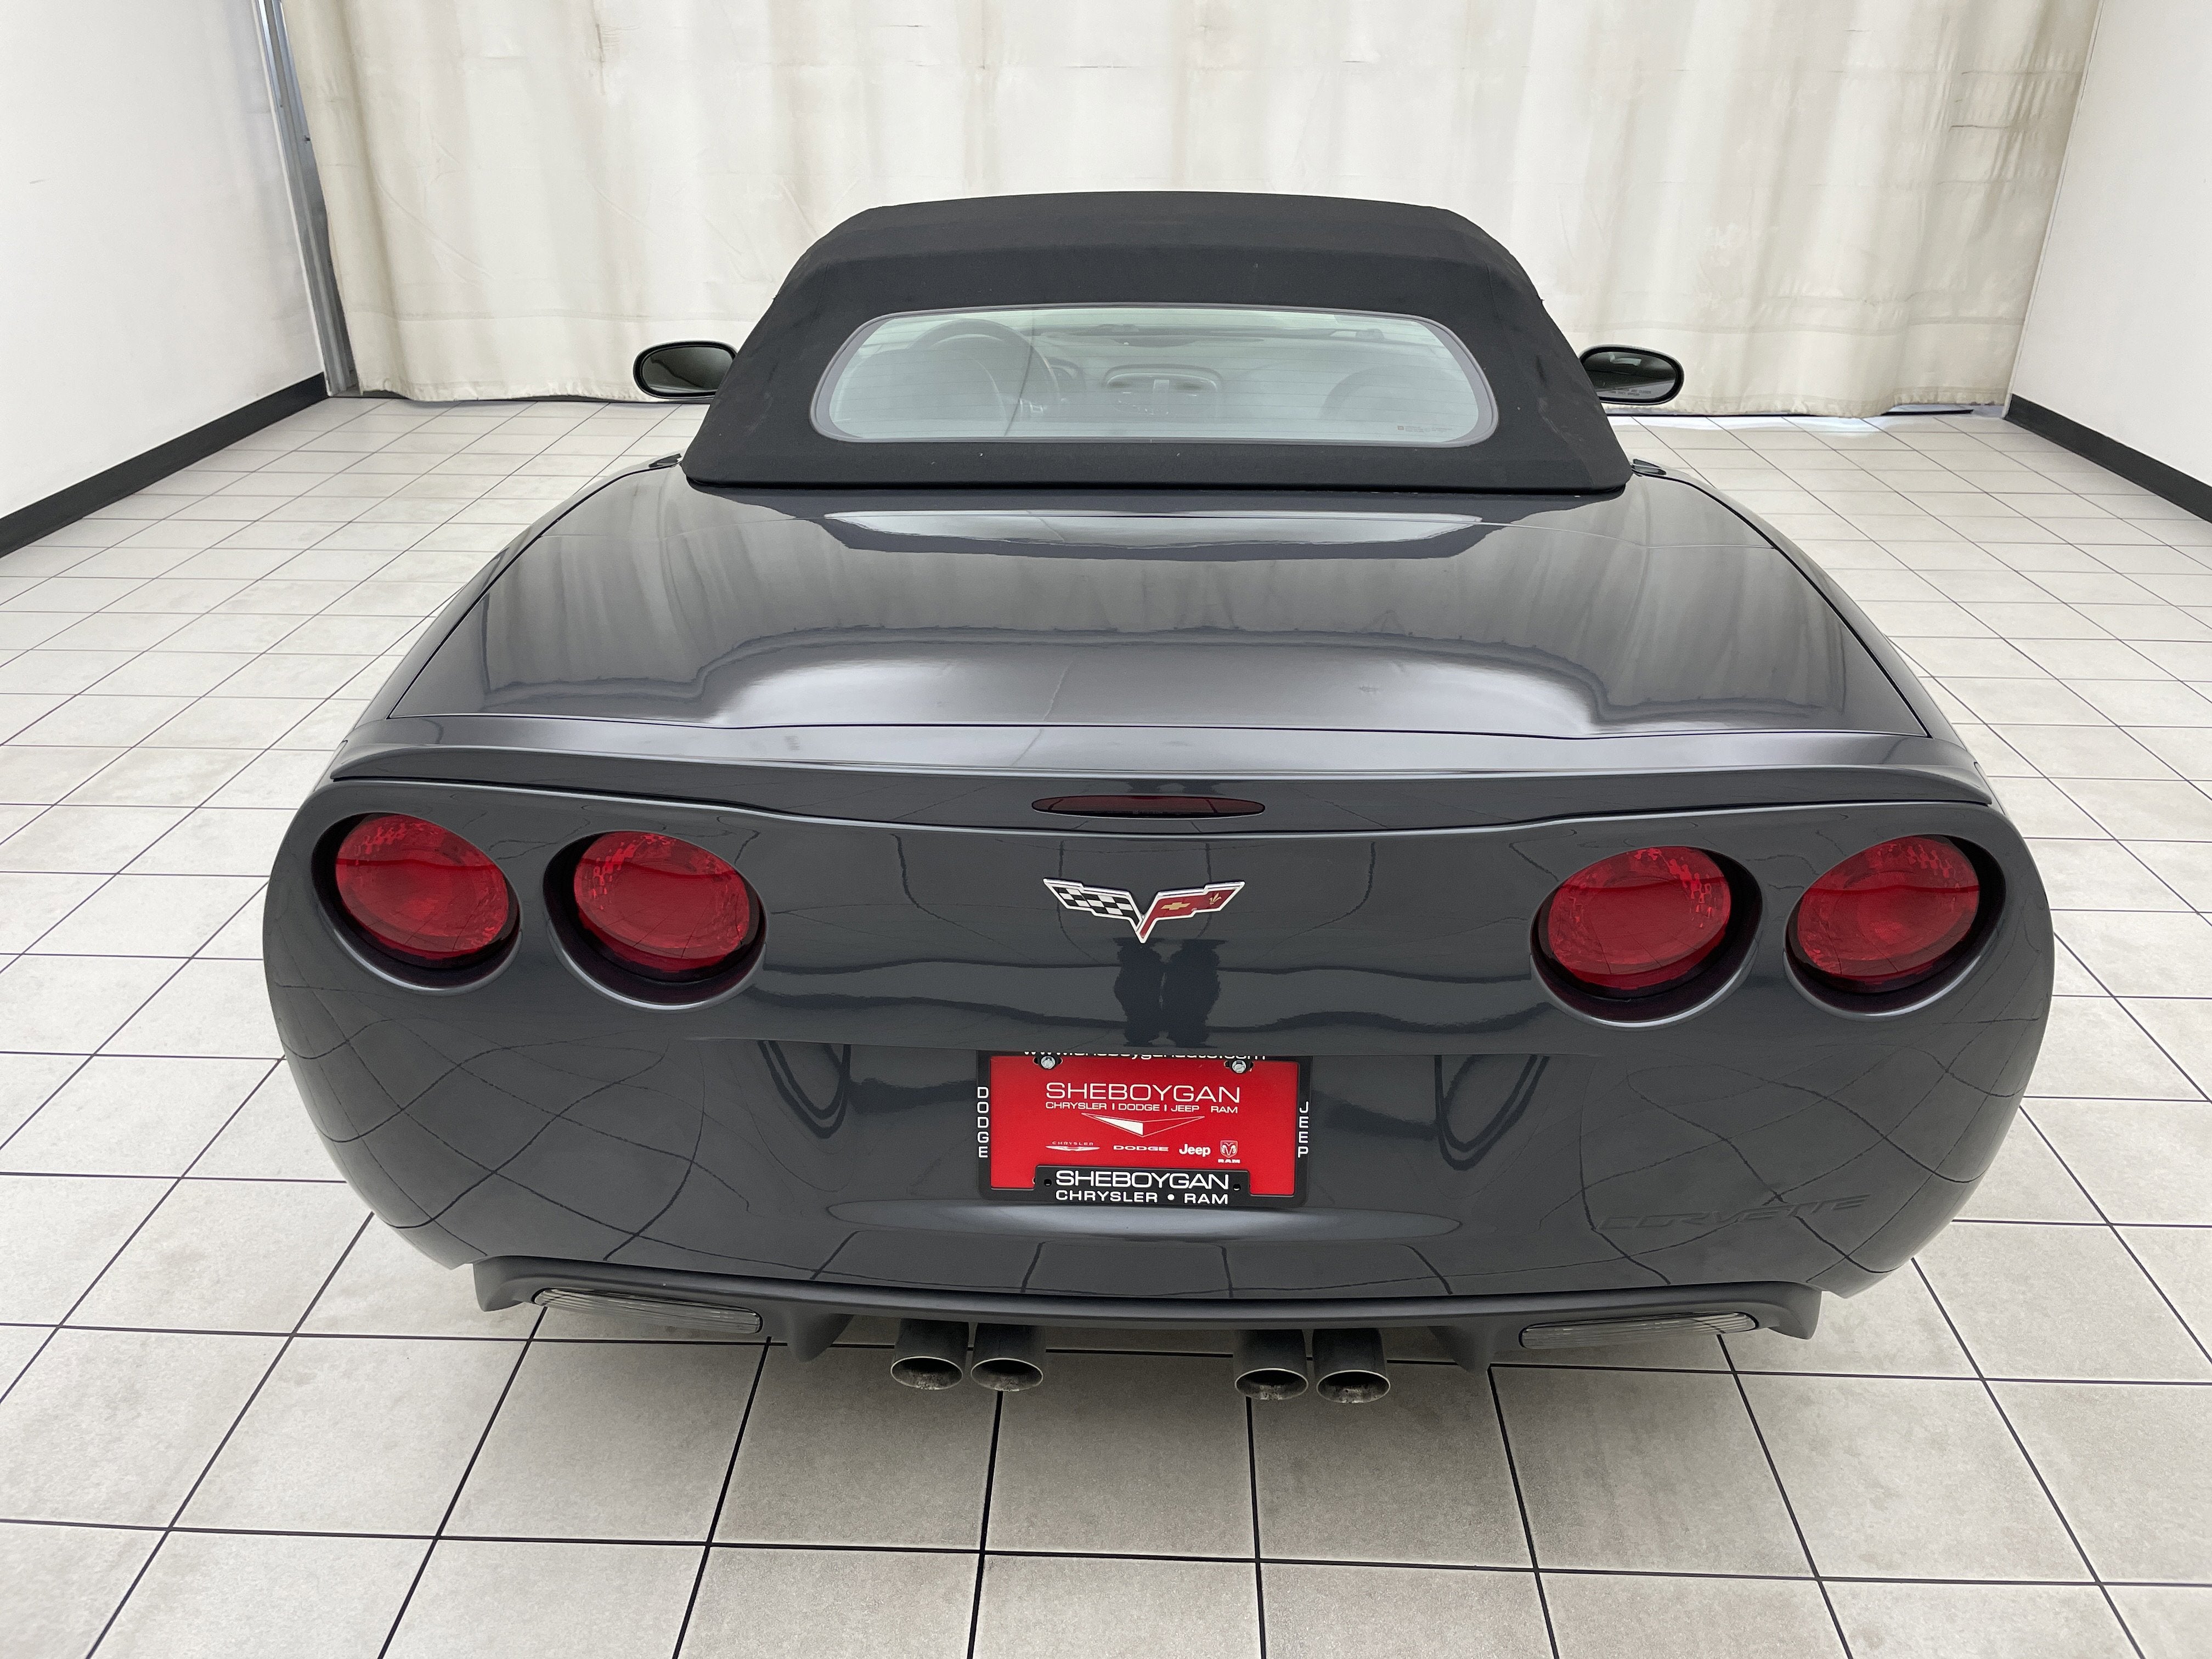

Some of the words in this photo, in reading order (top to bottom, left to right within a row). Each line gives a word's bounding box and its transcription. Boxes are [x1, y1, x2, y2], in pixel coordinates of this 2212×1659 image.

[1046, 1082, 1240, 1103] SHEBOYGAN
[1045, 1102, 1107, 1110] CHRYSLER
[1118, 1103, 1160, 1111] DODGE
[1171, 1104, 1200, 1113] JEEP
[1211, 1105, 1238, 1114] RAM
[977, 1086, 989, 1158] DODGE
[1297, 1101, 1309, 1158] JEEP
[1178, 1143, 1211, 1157] Jeep
[1056, 1170, 1229, 1190] SHEBOYGAN
[1055, 1190, 1158, 1203] CHRYSLER
[1184, 1193, 1228, 1205] RAM
